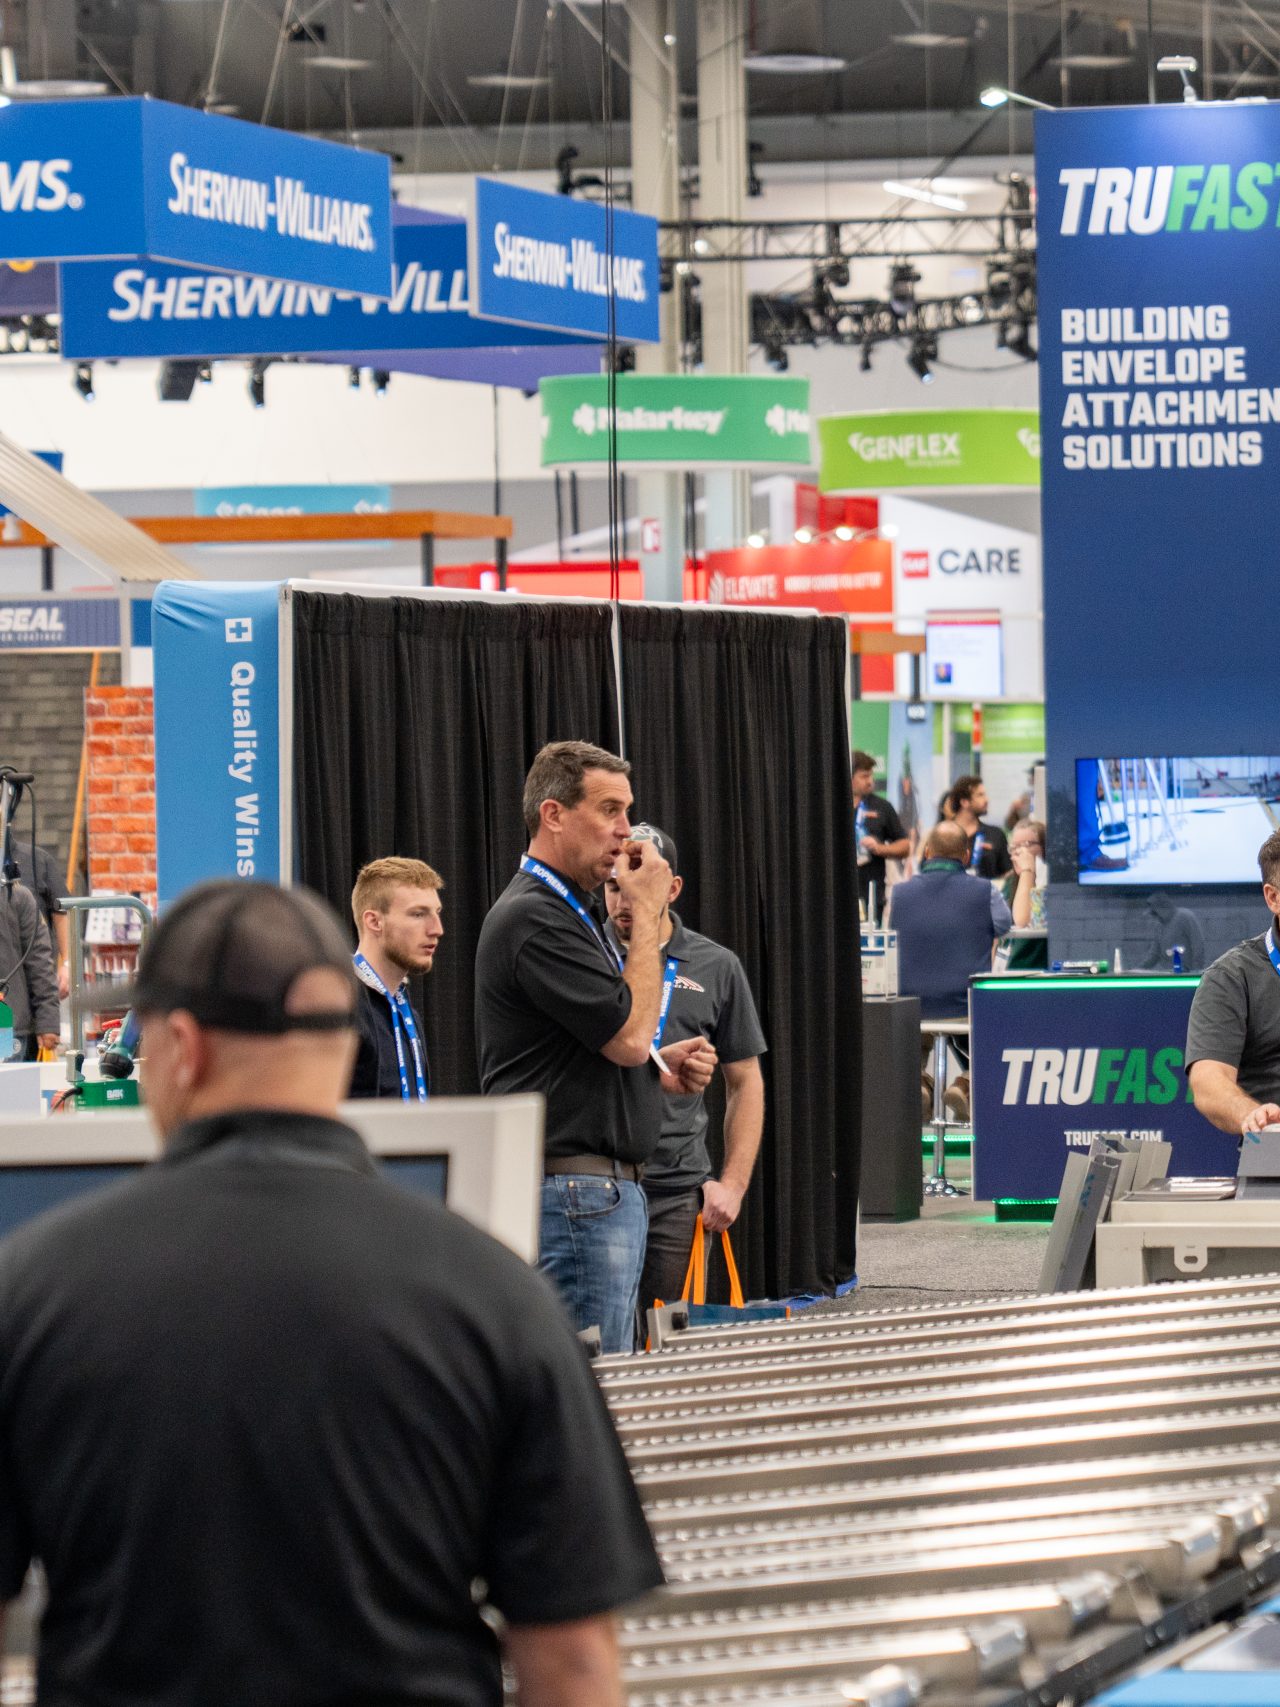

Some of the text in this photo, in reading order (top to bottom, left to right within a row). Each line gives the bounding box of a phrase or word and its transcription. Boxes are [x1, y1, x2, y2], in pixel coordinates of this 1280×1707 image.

[1061, 305, 1229, 344] BUILDING
[1062, 347, 1246, 385] ENVELOPE
[857, 432, 961, 462] GENFLEX
[1063, 431, 1262, 470] SOLUTIONS
[938, 549, 1021, 574] CARE
[228, 661, 260, 878] Quality Wins
[531, 864, 569, 898] SOPREMA
[1001, 1047, 1195, 1106] TRUFAS
